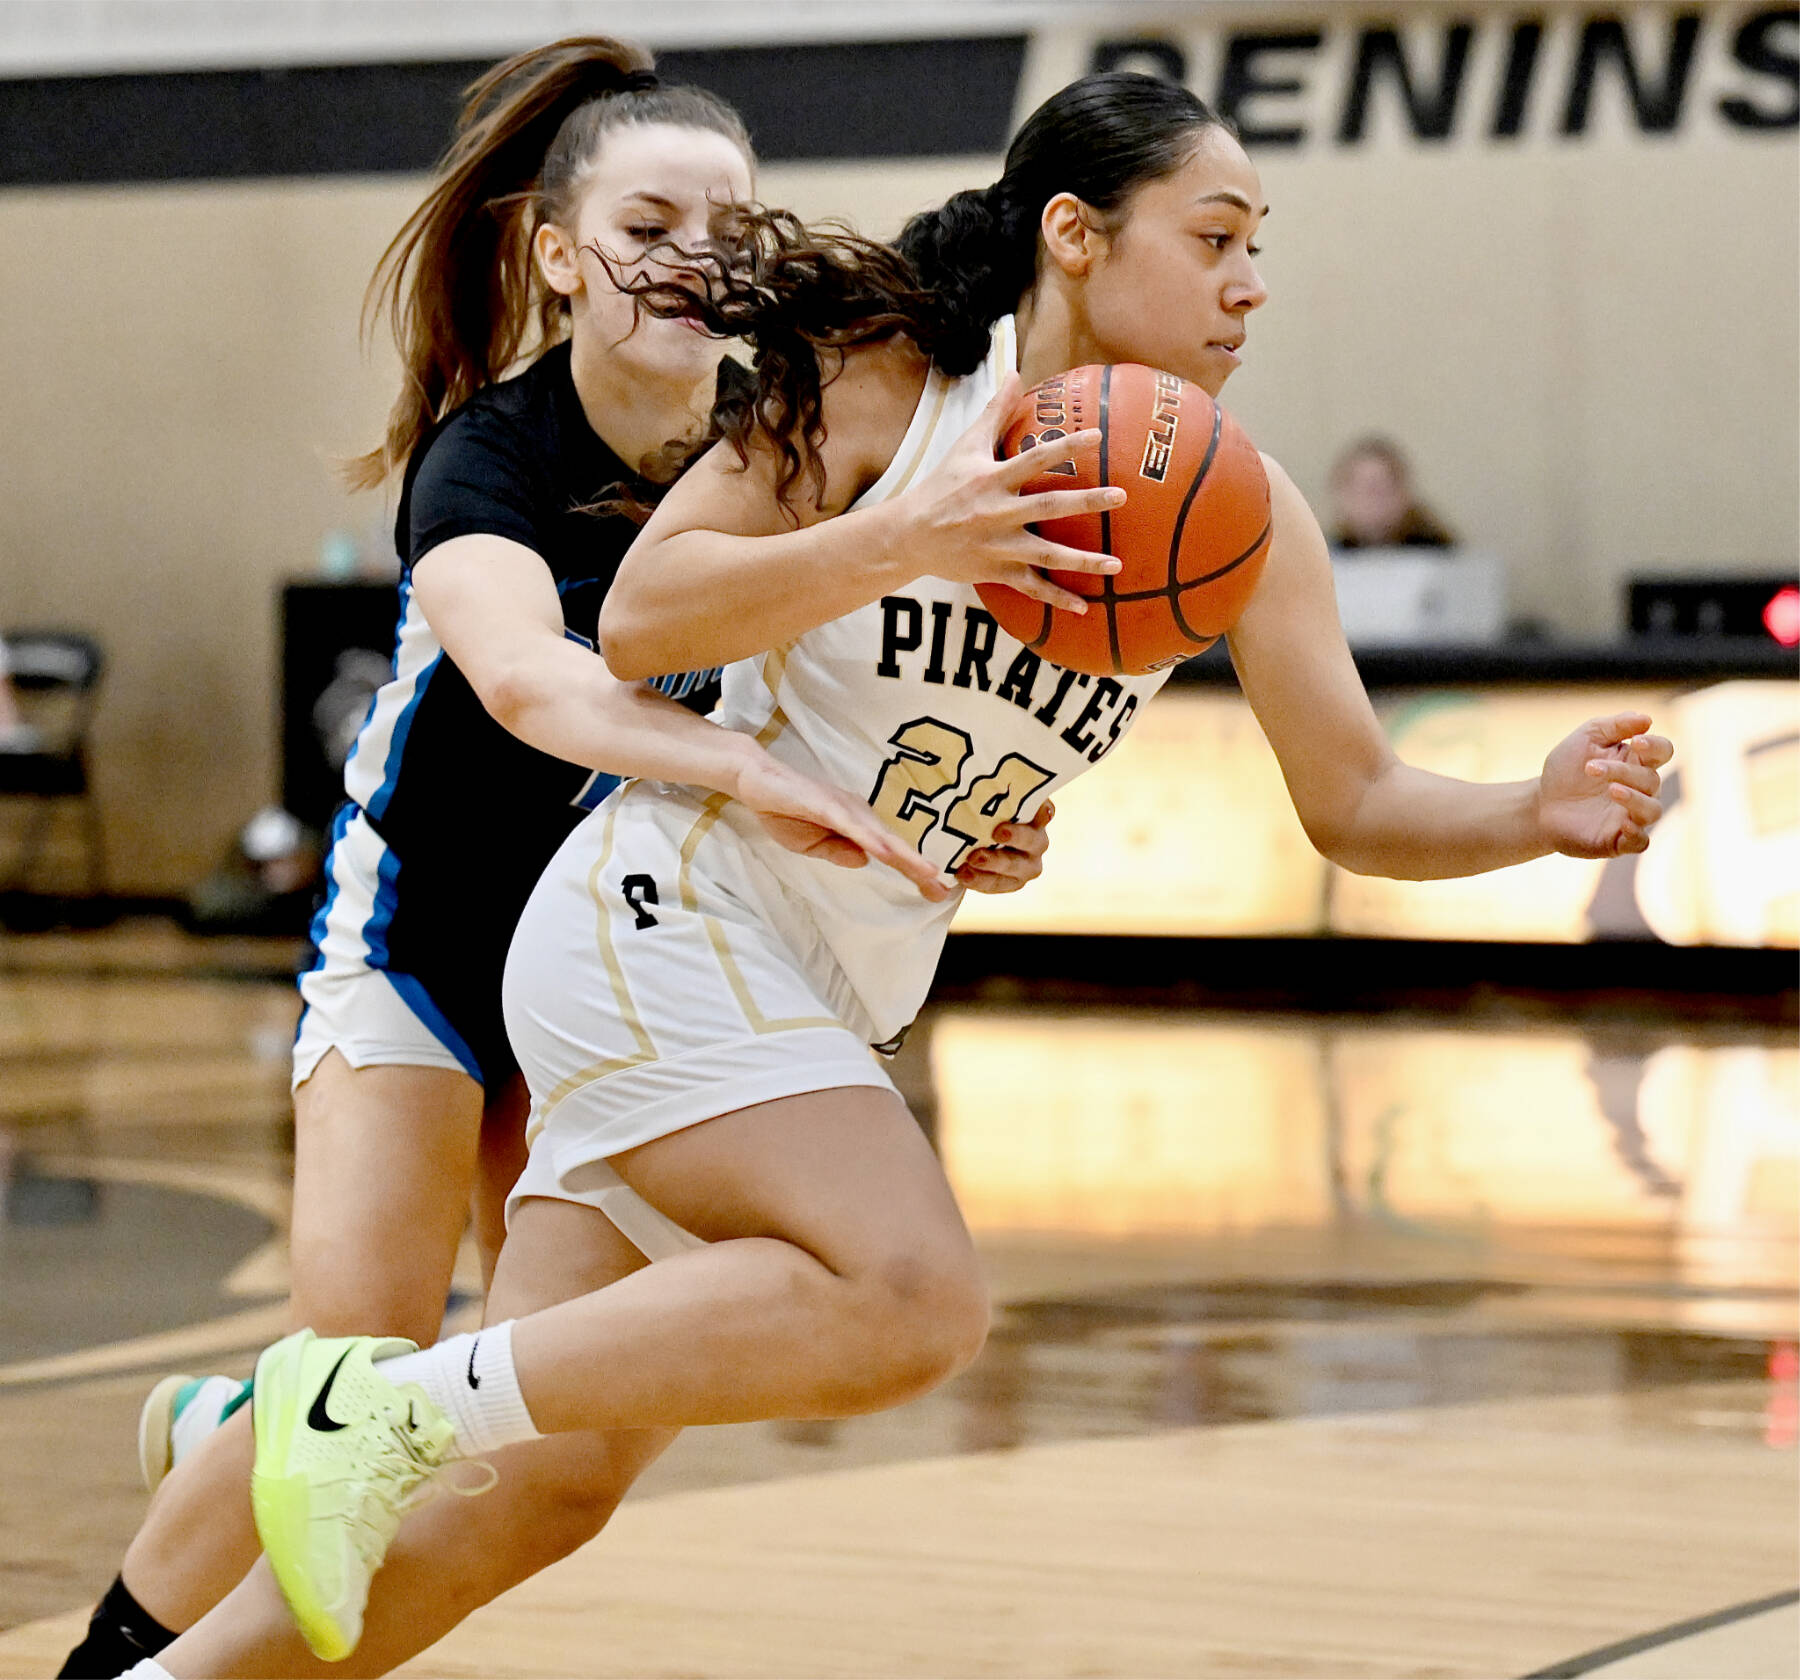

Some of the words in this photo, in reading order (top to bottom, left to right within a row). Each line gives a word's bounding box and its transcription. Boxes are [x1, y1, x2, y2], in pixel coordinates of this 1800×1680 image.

[1139, 371, 1183, 484] ELITE
[877, 595, 1138, 763] PIRATES
[867, 715, 1057, 875] 24
